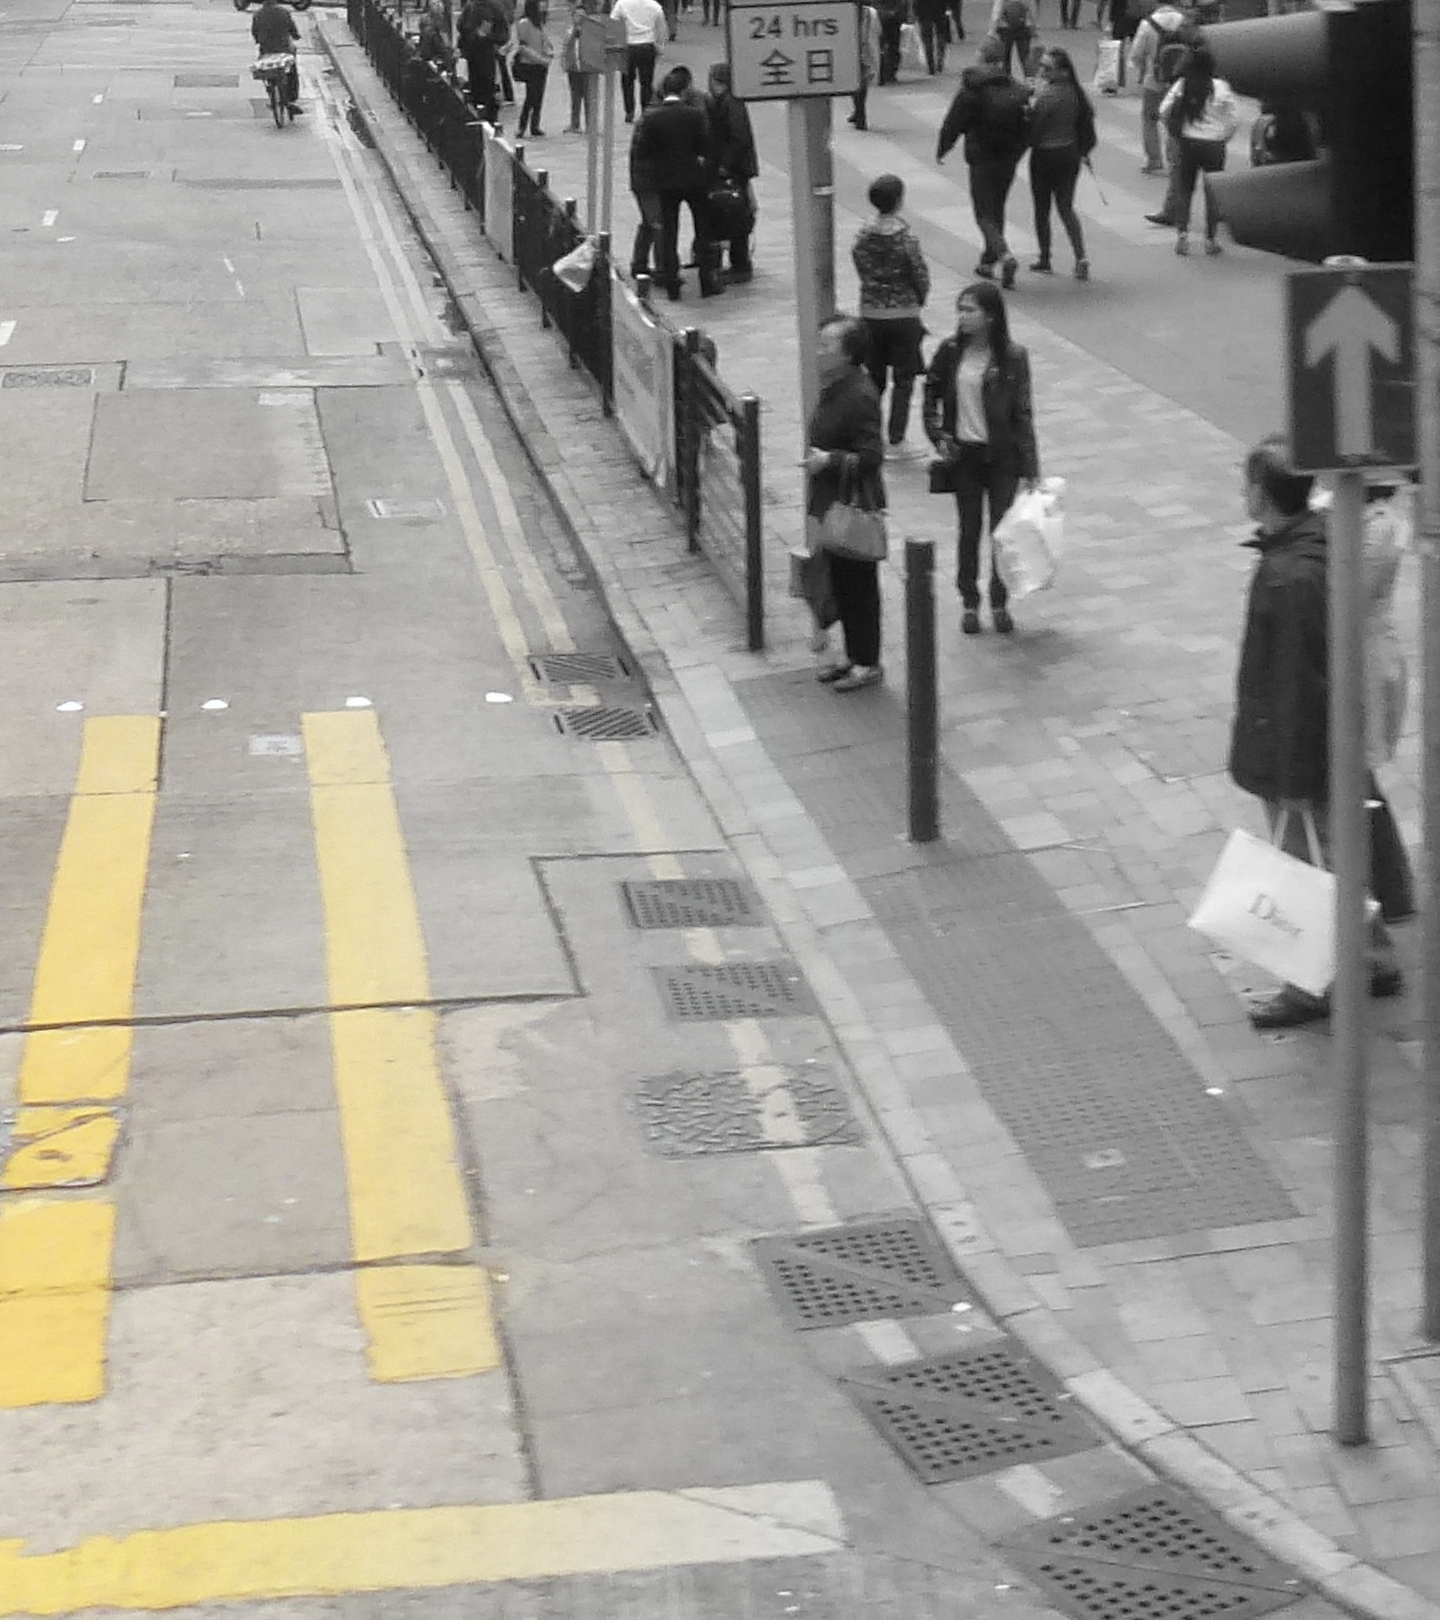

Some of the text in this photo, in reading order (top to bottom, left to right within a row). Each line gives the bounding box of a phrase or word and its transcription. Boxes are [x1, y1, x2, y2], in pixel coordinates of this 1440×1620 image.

[749, 14, 840, 40] 24 hrs
[761, 48, 835, 86] 全日
